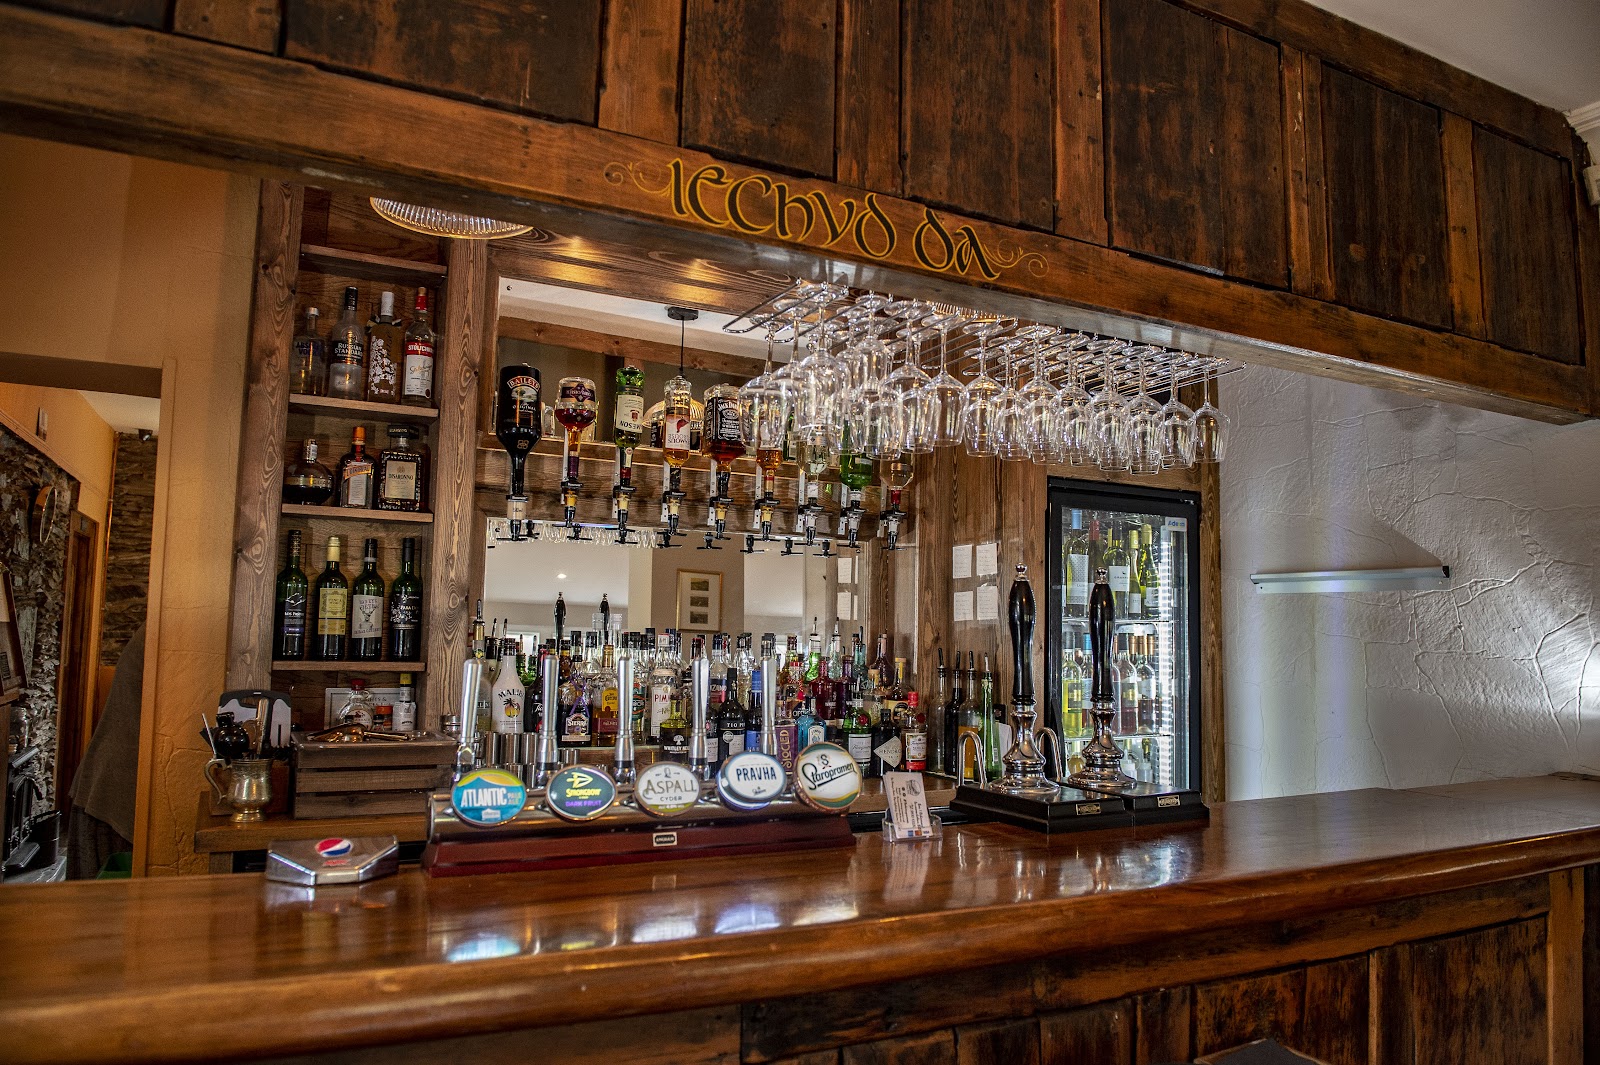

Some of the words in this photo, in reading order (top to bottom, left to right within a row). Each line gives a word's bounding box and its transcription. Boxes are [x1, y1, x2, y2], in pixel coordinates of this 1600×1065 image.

[735, 766, 777, 782] PRAVHA
[801, 762, 857, 790] Staropramen
[460, 787, 507, 808] ATLANTIC
[643, 779, 698, 798] ASPALL
